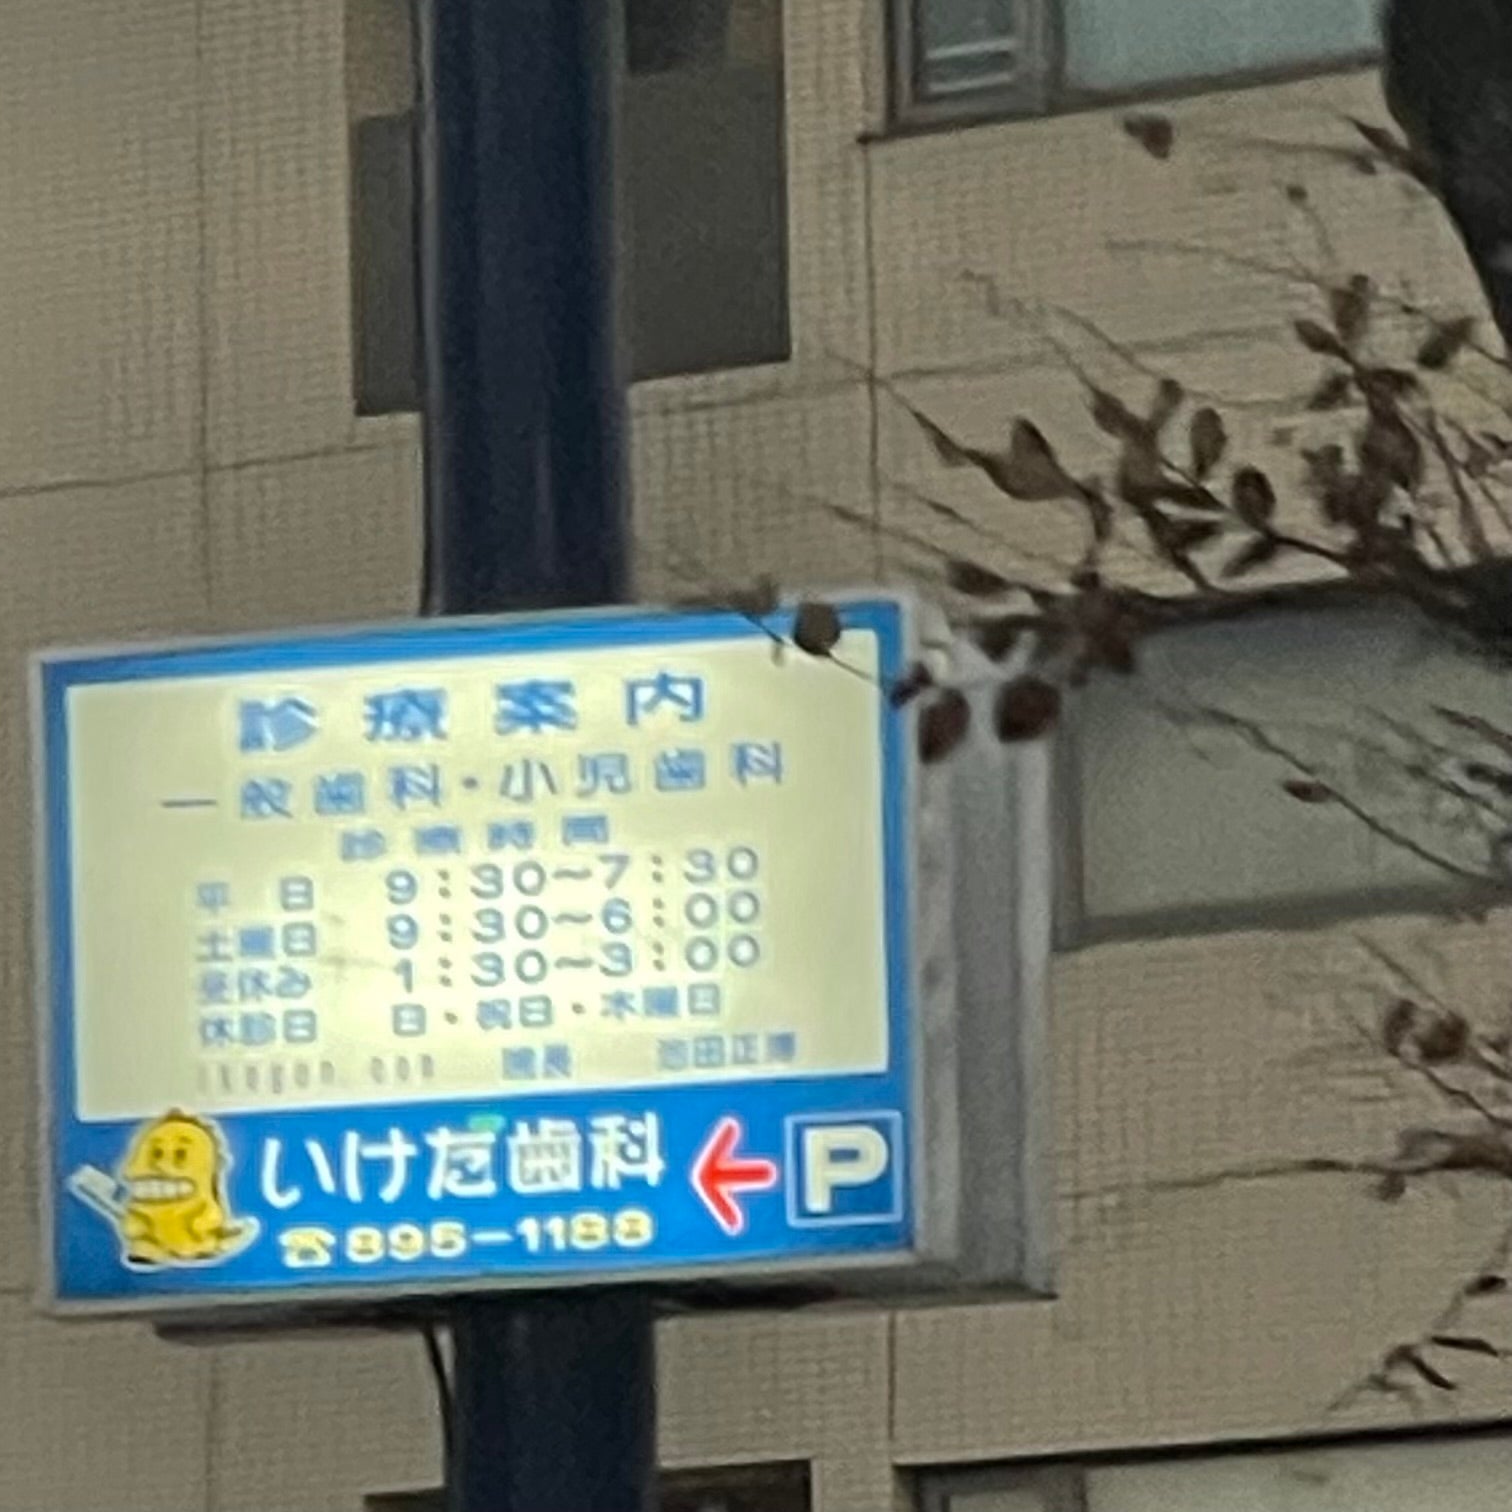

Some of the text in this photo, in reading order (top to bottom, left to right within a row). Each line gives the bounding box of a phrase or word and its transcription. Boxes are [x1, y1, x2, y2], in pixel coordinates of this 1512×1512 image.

[262, 1110, 665, 1209] いけだ歯科
[804, 1125, 888, 1213] P
